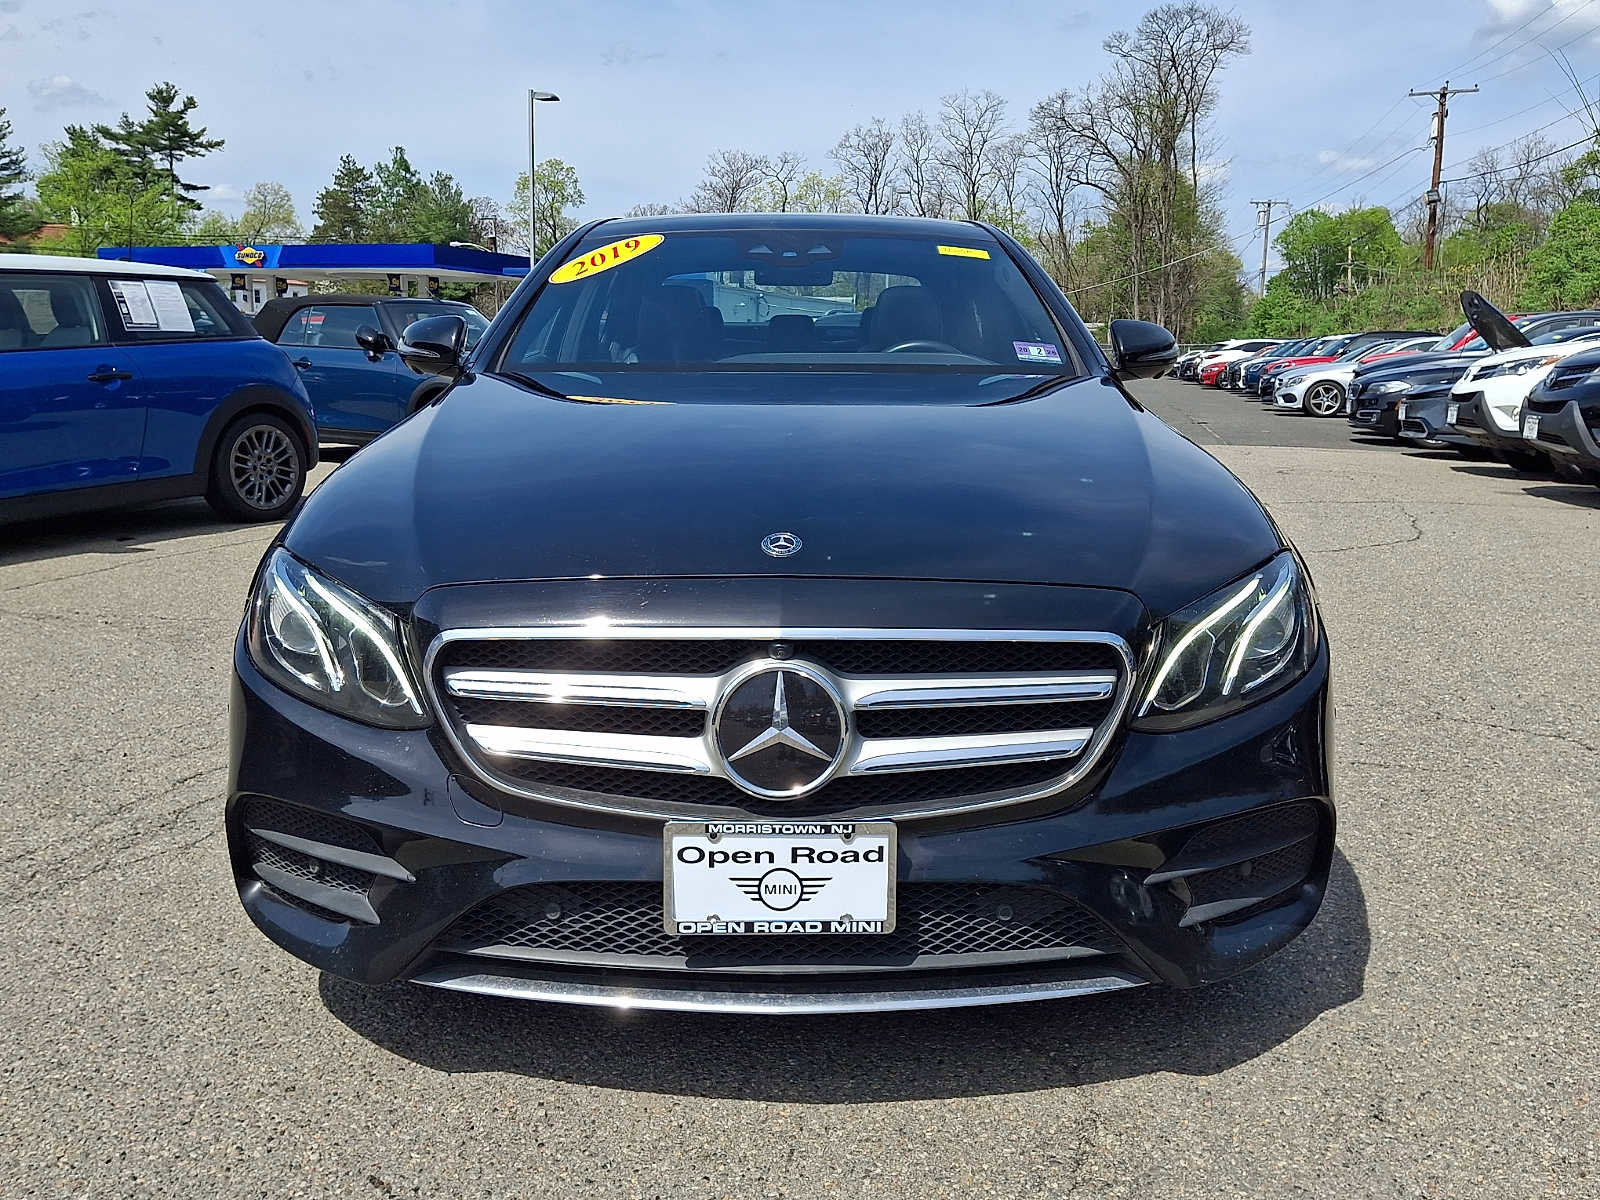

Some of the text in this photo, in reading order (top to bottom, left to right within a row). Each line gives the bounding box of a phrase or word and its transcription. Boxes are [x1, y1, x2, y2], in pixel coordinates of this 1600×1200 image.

[572, 239, 641, 276] 2019
[708, 824, 853, 834] MORRISTOWN, NJ
[677, 845, 884, 868] Open Road
[764, 884, 797, 895] MINI
[678, 921, 882, 933] OPEN ROAD MINI
